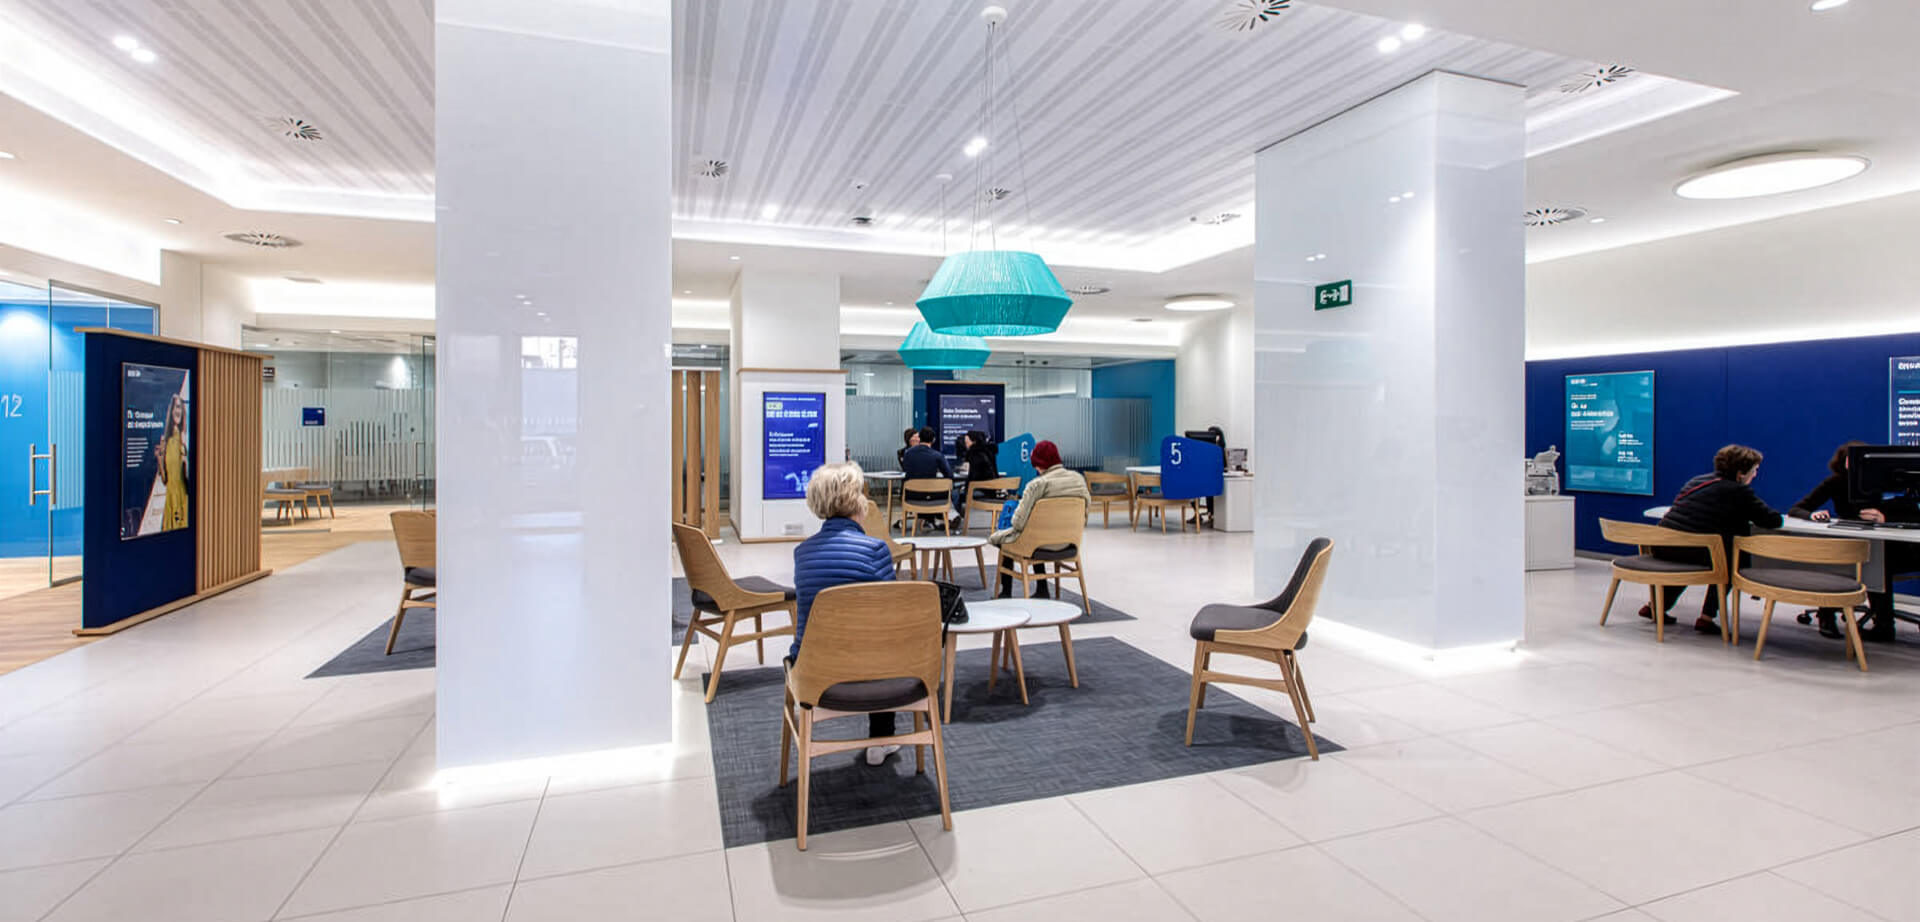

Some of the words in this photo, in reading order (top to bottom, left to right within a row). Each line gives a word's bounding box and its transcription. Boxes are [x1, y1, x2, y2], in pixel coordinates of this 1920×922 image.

[1, 394, 23, 418] 12
[1021, 441, 1029, 462] 6
[1171, 442, 1182, 465] 5
